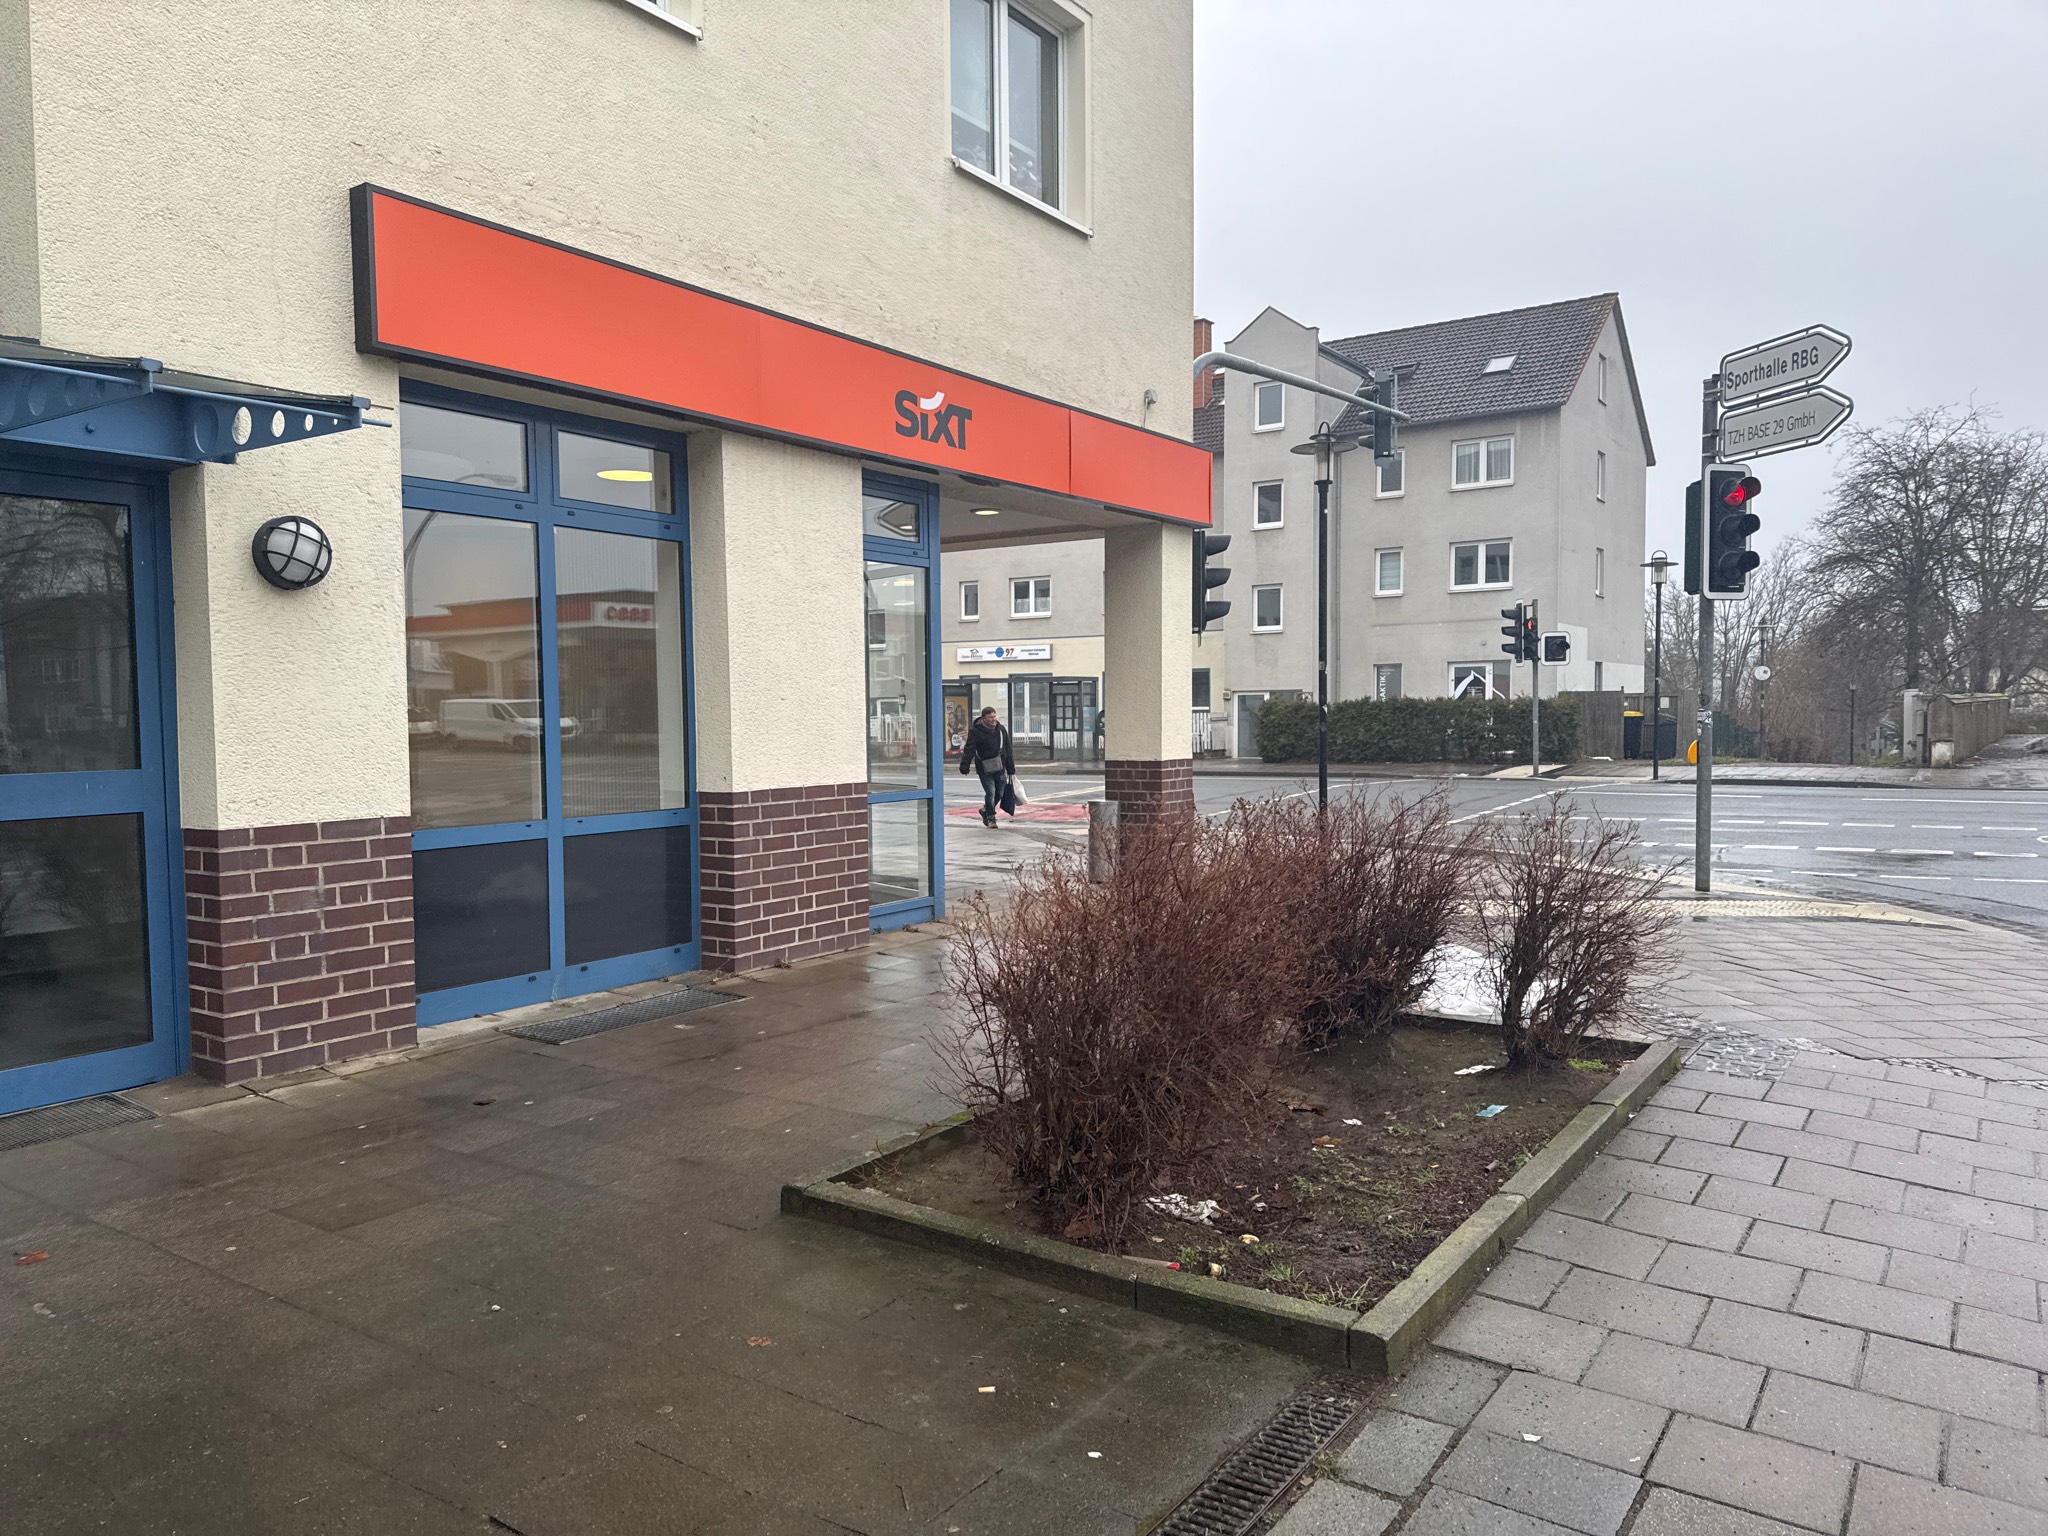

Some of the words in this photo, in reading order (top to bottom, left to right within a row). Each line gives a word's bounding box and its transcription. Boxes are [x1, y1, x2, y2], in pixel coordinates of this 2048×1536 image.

[1727, 357, 1788, 391] Sporthalle
[1791, 346, 1819, 371] RBG
[1728, 428, 1745, 445] TZH
[1748, 422, 1770, 441] BASE
[1773, 419, 1785, 434] 29
[1787, 410, 1816, 431] GmbH
[1005, 648, 1015, 657] 97
